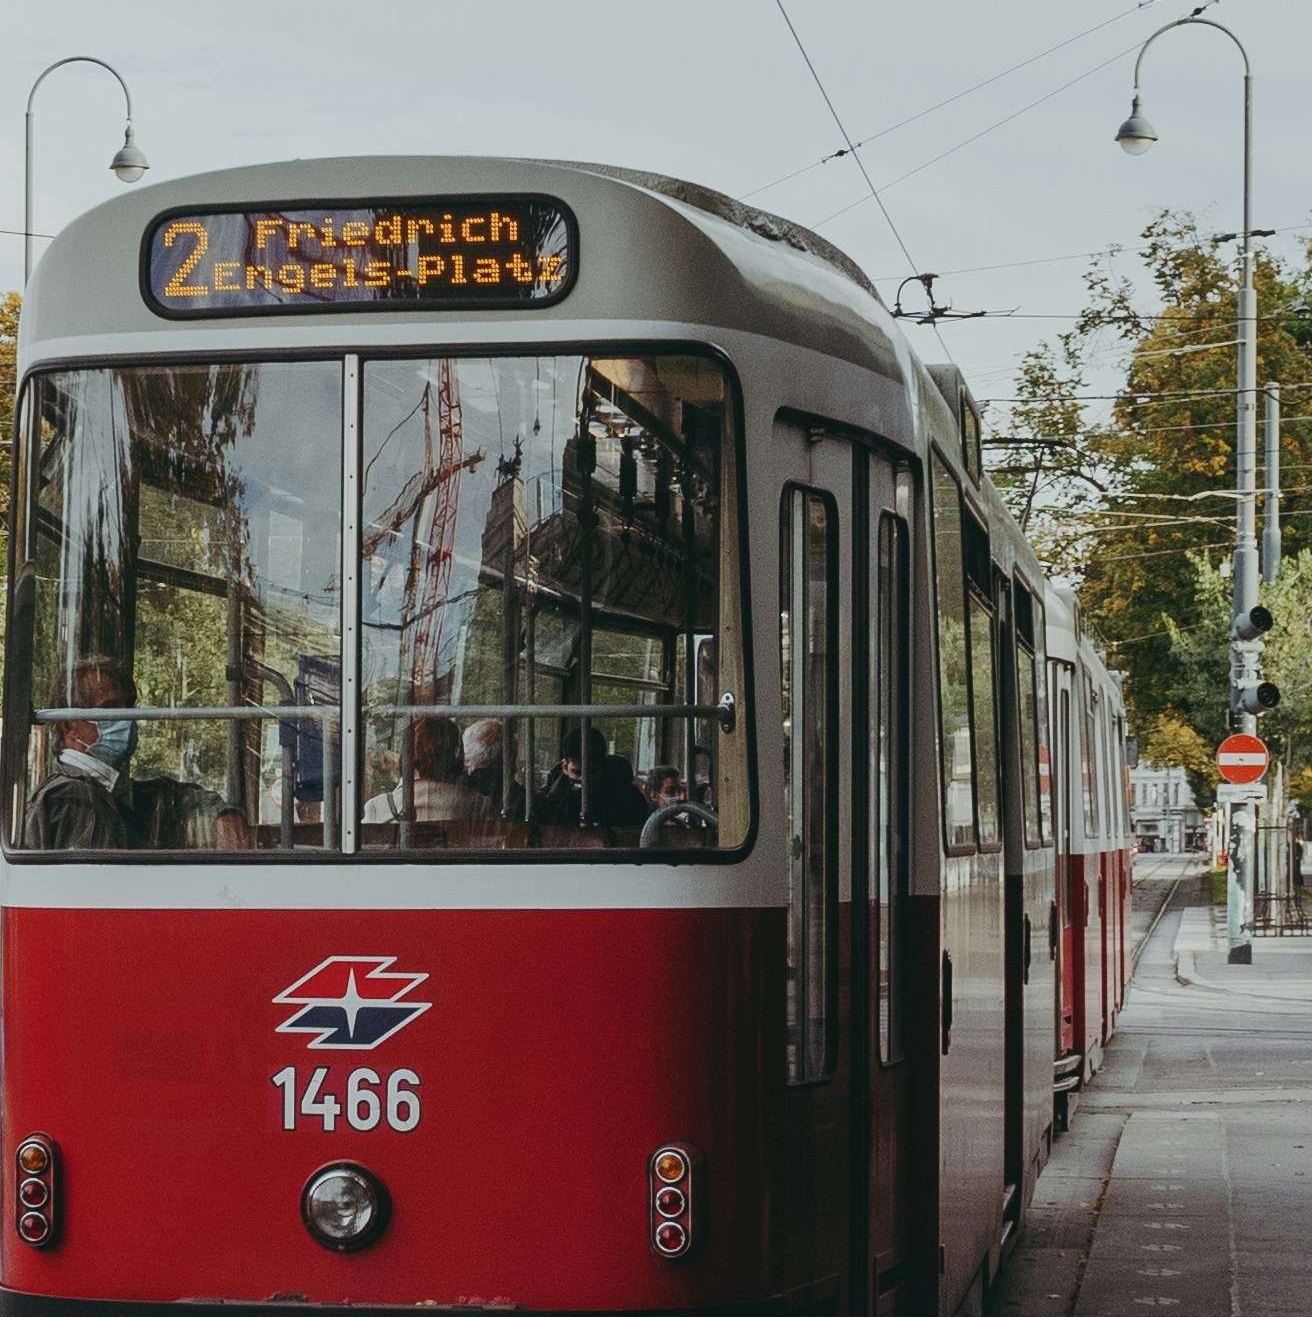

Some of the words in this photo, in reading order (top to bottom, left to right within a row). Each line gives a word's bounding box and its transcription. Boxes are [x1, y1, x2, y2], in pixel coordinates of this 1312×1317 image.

[255, 212, 520, 249] Friedrich
[163, 221, 209, 298] 2
[213, 252, 563, 294] Engels-Platz
[270, 1065, 423, 1133] 1466
